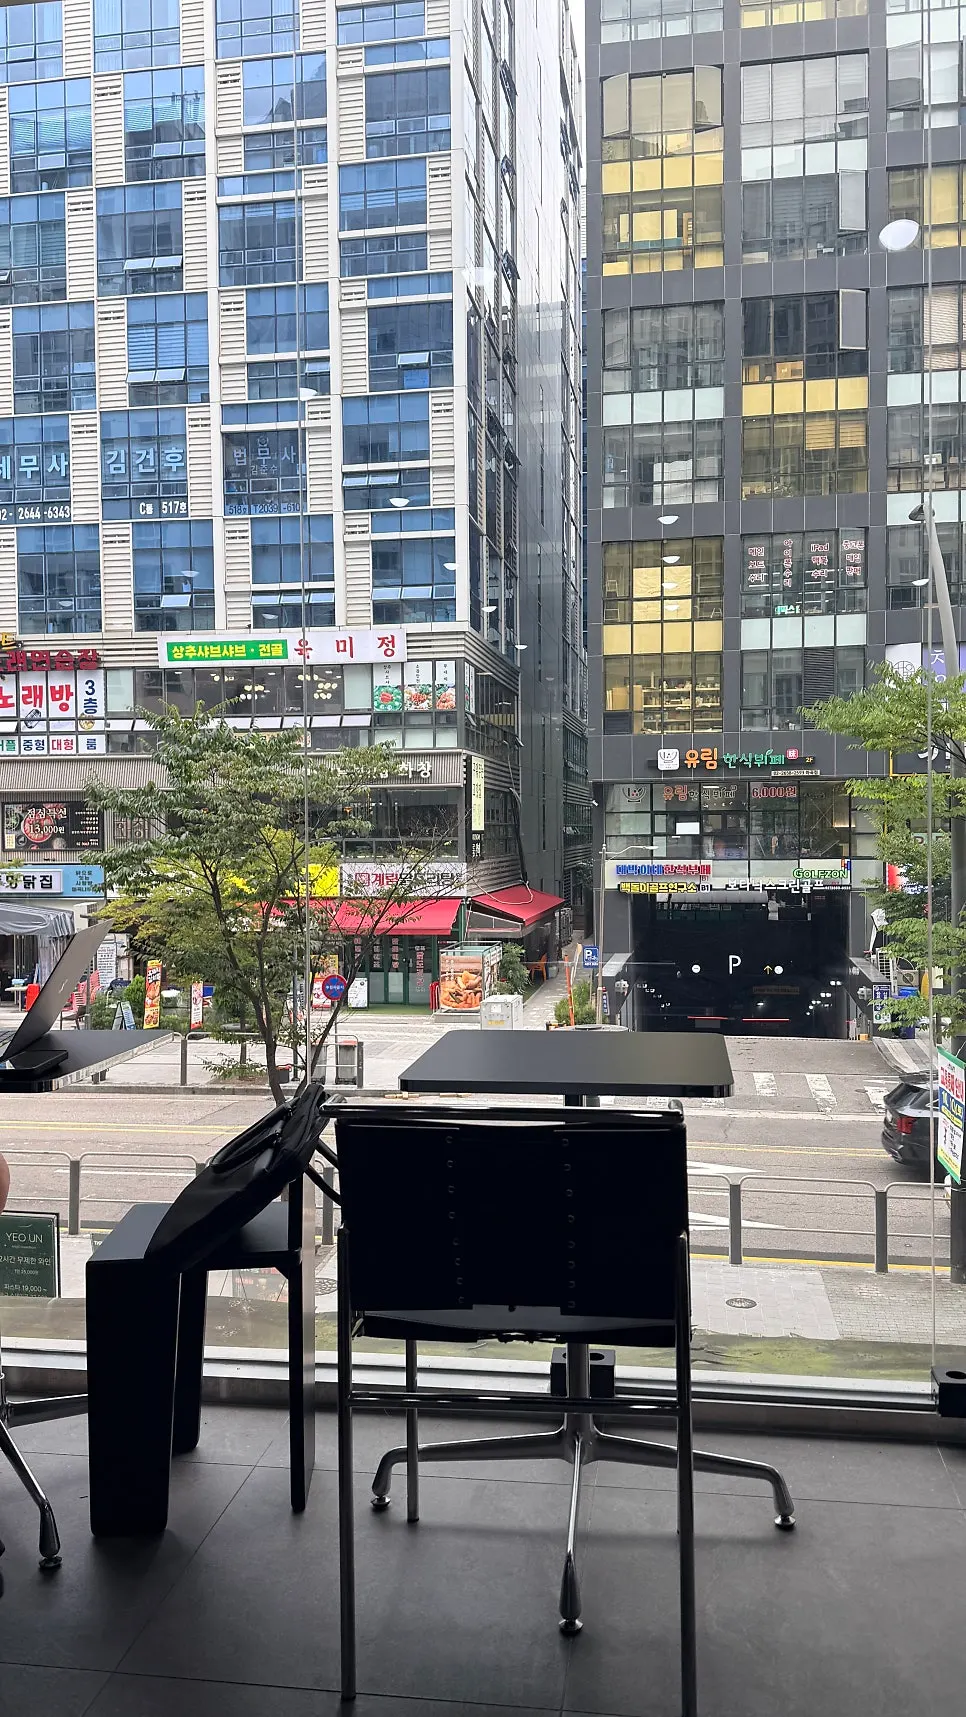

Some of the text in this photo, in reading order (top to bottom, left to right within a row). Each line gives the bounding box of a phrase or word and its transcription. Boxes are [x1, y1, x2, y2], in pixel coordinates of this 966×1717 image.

[106, 446, 184, 475] 김건후
[18, 506, 41, 520] 2644
[161, 500, 187, 514] 517호
[811, 543, 829, 552] iPad
[172, 643, 284, 659] 상추샤브샤브 전골
[0, 648, 100, 671] 래연습장
[23, 739, 45, 751] 중형
[52, 739, 74, 750] 대형
[86, 738, 97, 750] 룸
[684, 748, 718, 770] 유림
[723, 749, 785, 768] 한식뷔페
[663, 784, 688, 801] 유림
[751, 786, 797, 799] 6,000원
[30, 823, 65, 834] 13,000원
[793, 867, 848, 879] GOLFZON
[726, 878, 824, 894] 보타닉스크린골프
[585, 949, 592, 960] P
[728, 954, 741, 975] P
[5, 1233, 43, 1243] YEO UN
